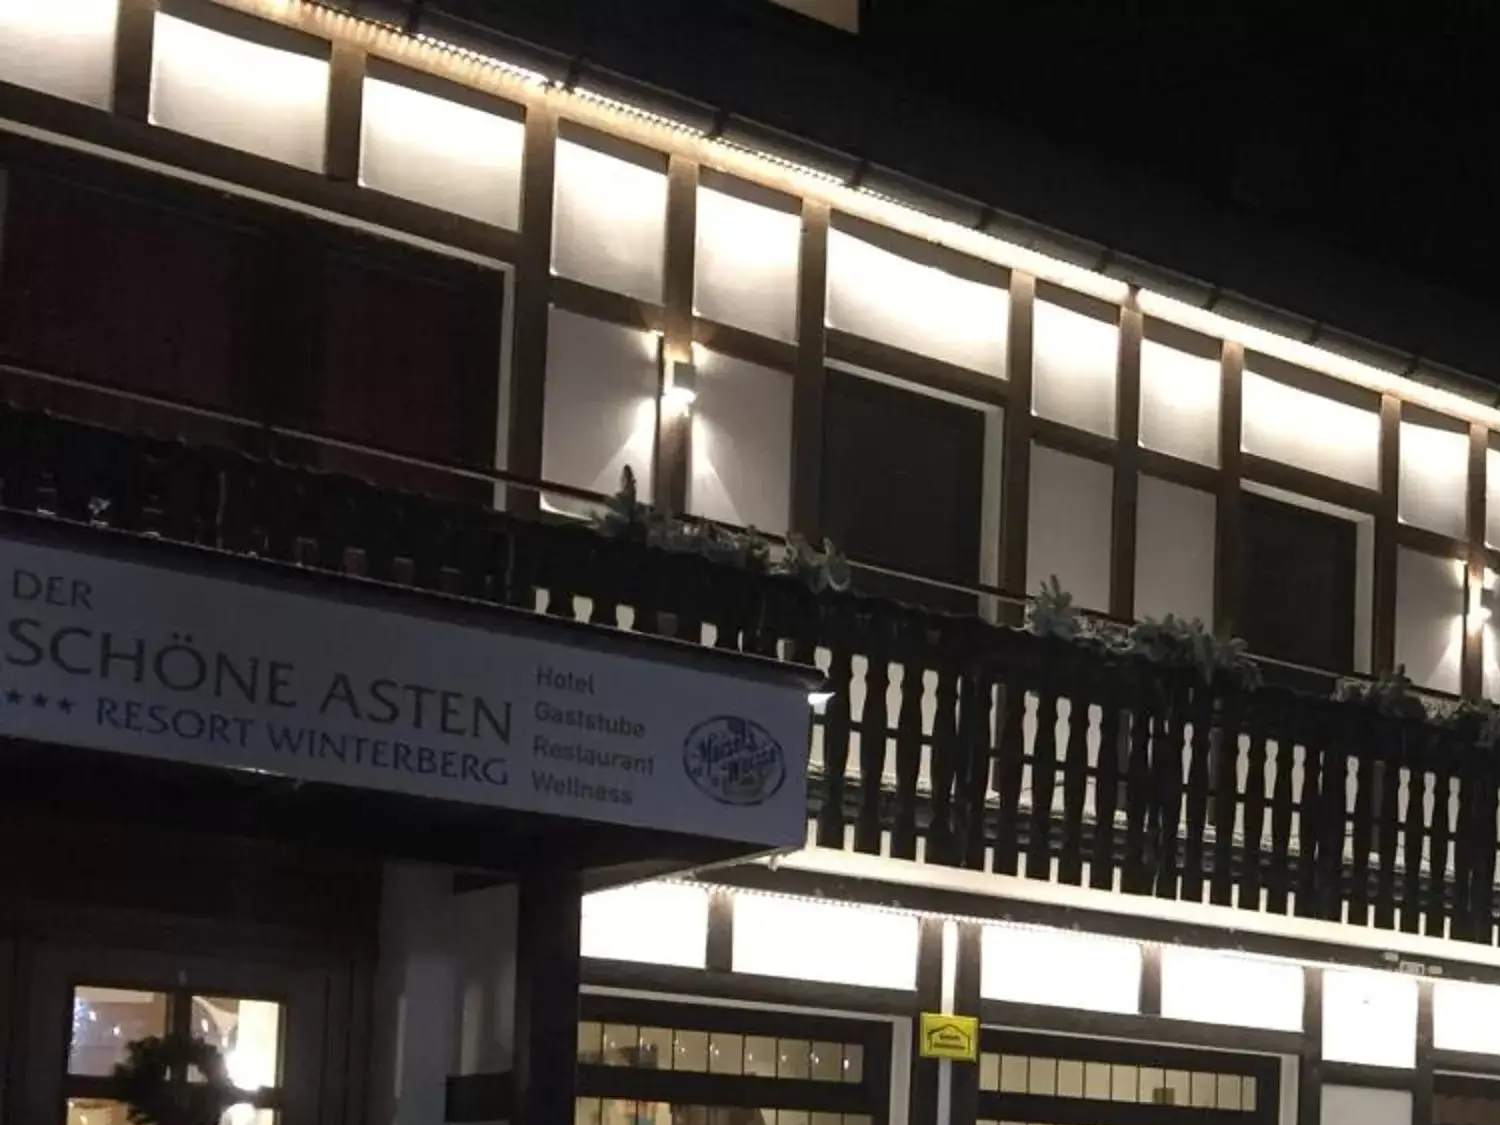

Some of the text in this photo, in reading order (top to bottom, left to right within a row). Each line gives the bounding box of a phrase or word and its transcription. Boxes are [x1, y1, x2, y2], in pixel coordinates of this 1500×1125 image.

[13, 568, 94, 611] DER
[5, 617, 513, 747] SCHÖNE ASTEN
[536, 662, 595, 696] Hotel
[533, 699, 647, 739] Gaststube
[96, 696, 509, 786] RESORT WINTERBERG
[532, 734, 656, 777] Restaurant
[531, 768, 634, 806] Wellness
